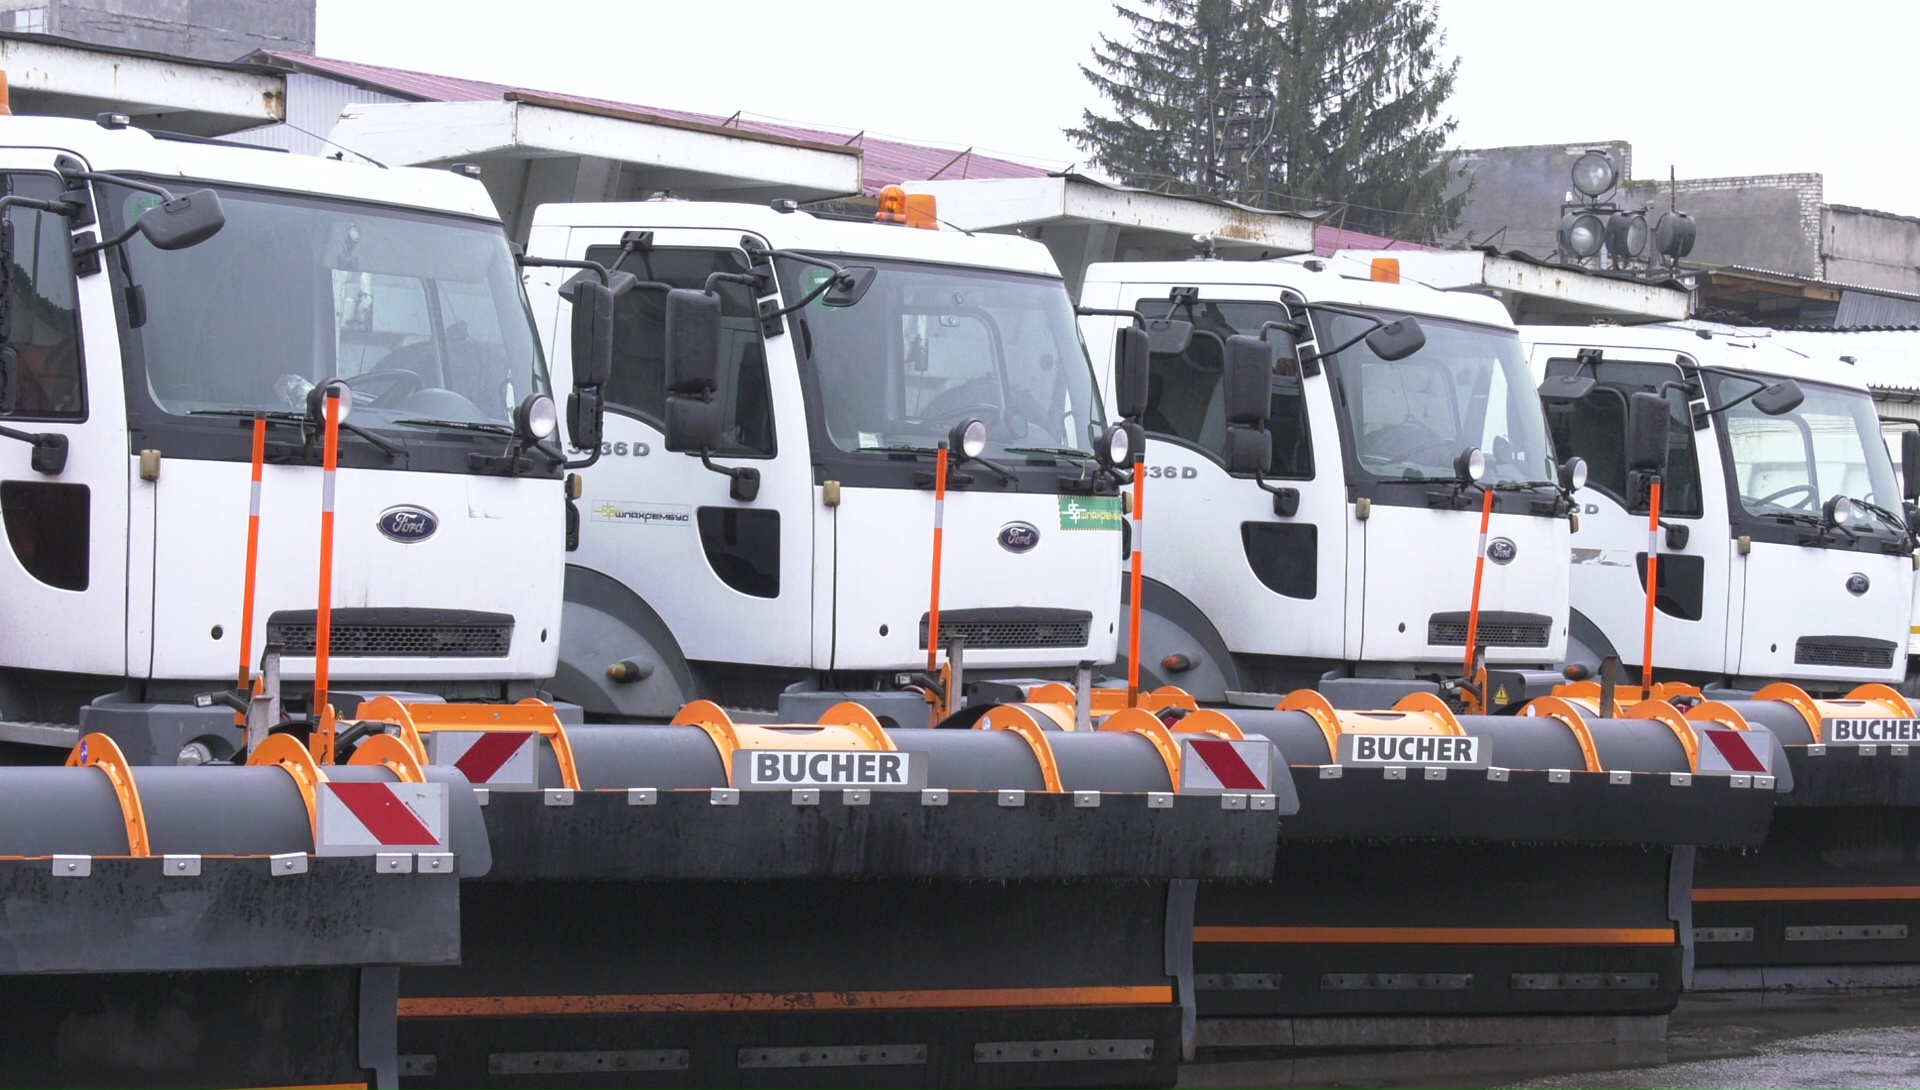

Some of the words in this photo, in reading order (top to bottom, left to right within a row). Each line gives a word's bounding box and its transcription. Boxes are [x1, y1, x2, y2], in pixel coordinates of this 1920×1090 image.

[633, 442, 650, 457] D
[1181, 466, 1198, 479] D
[392, 512, 426, 533] Ford
[1007, 527, 1031, 545] Ford
[1493, 542, 1512, 558] Ford
[1835, 720, 1920, 740] BUCHER
[1357, 736, 1472, 762] BUCHER
[757, 753, 902, 783] BUCHER
